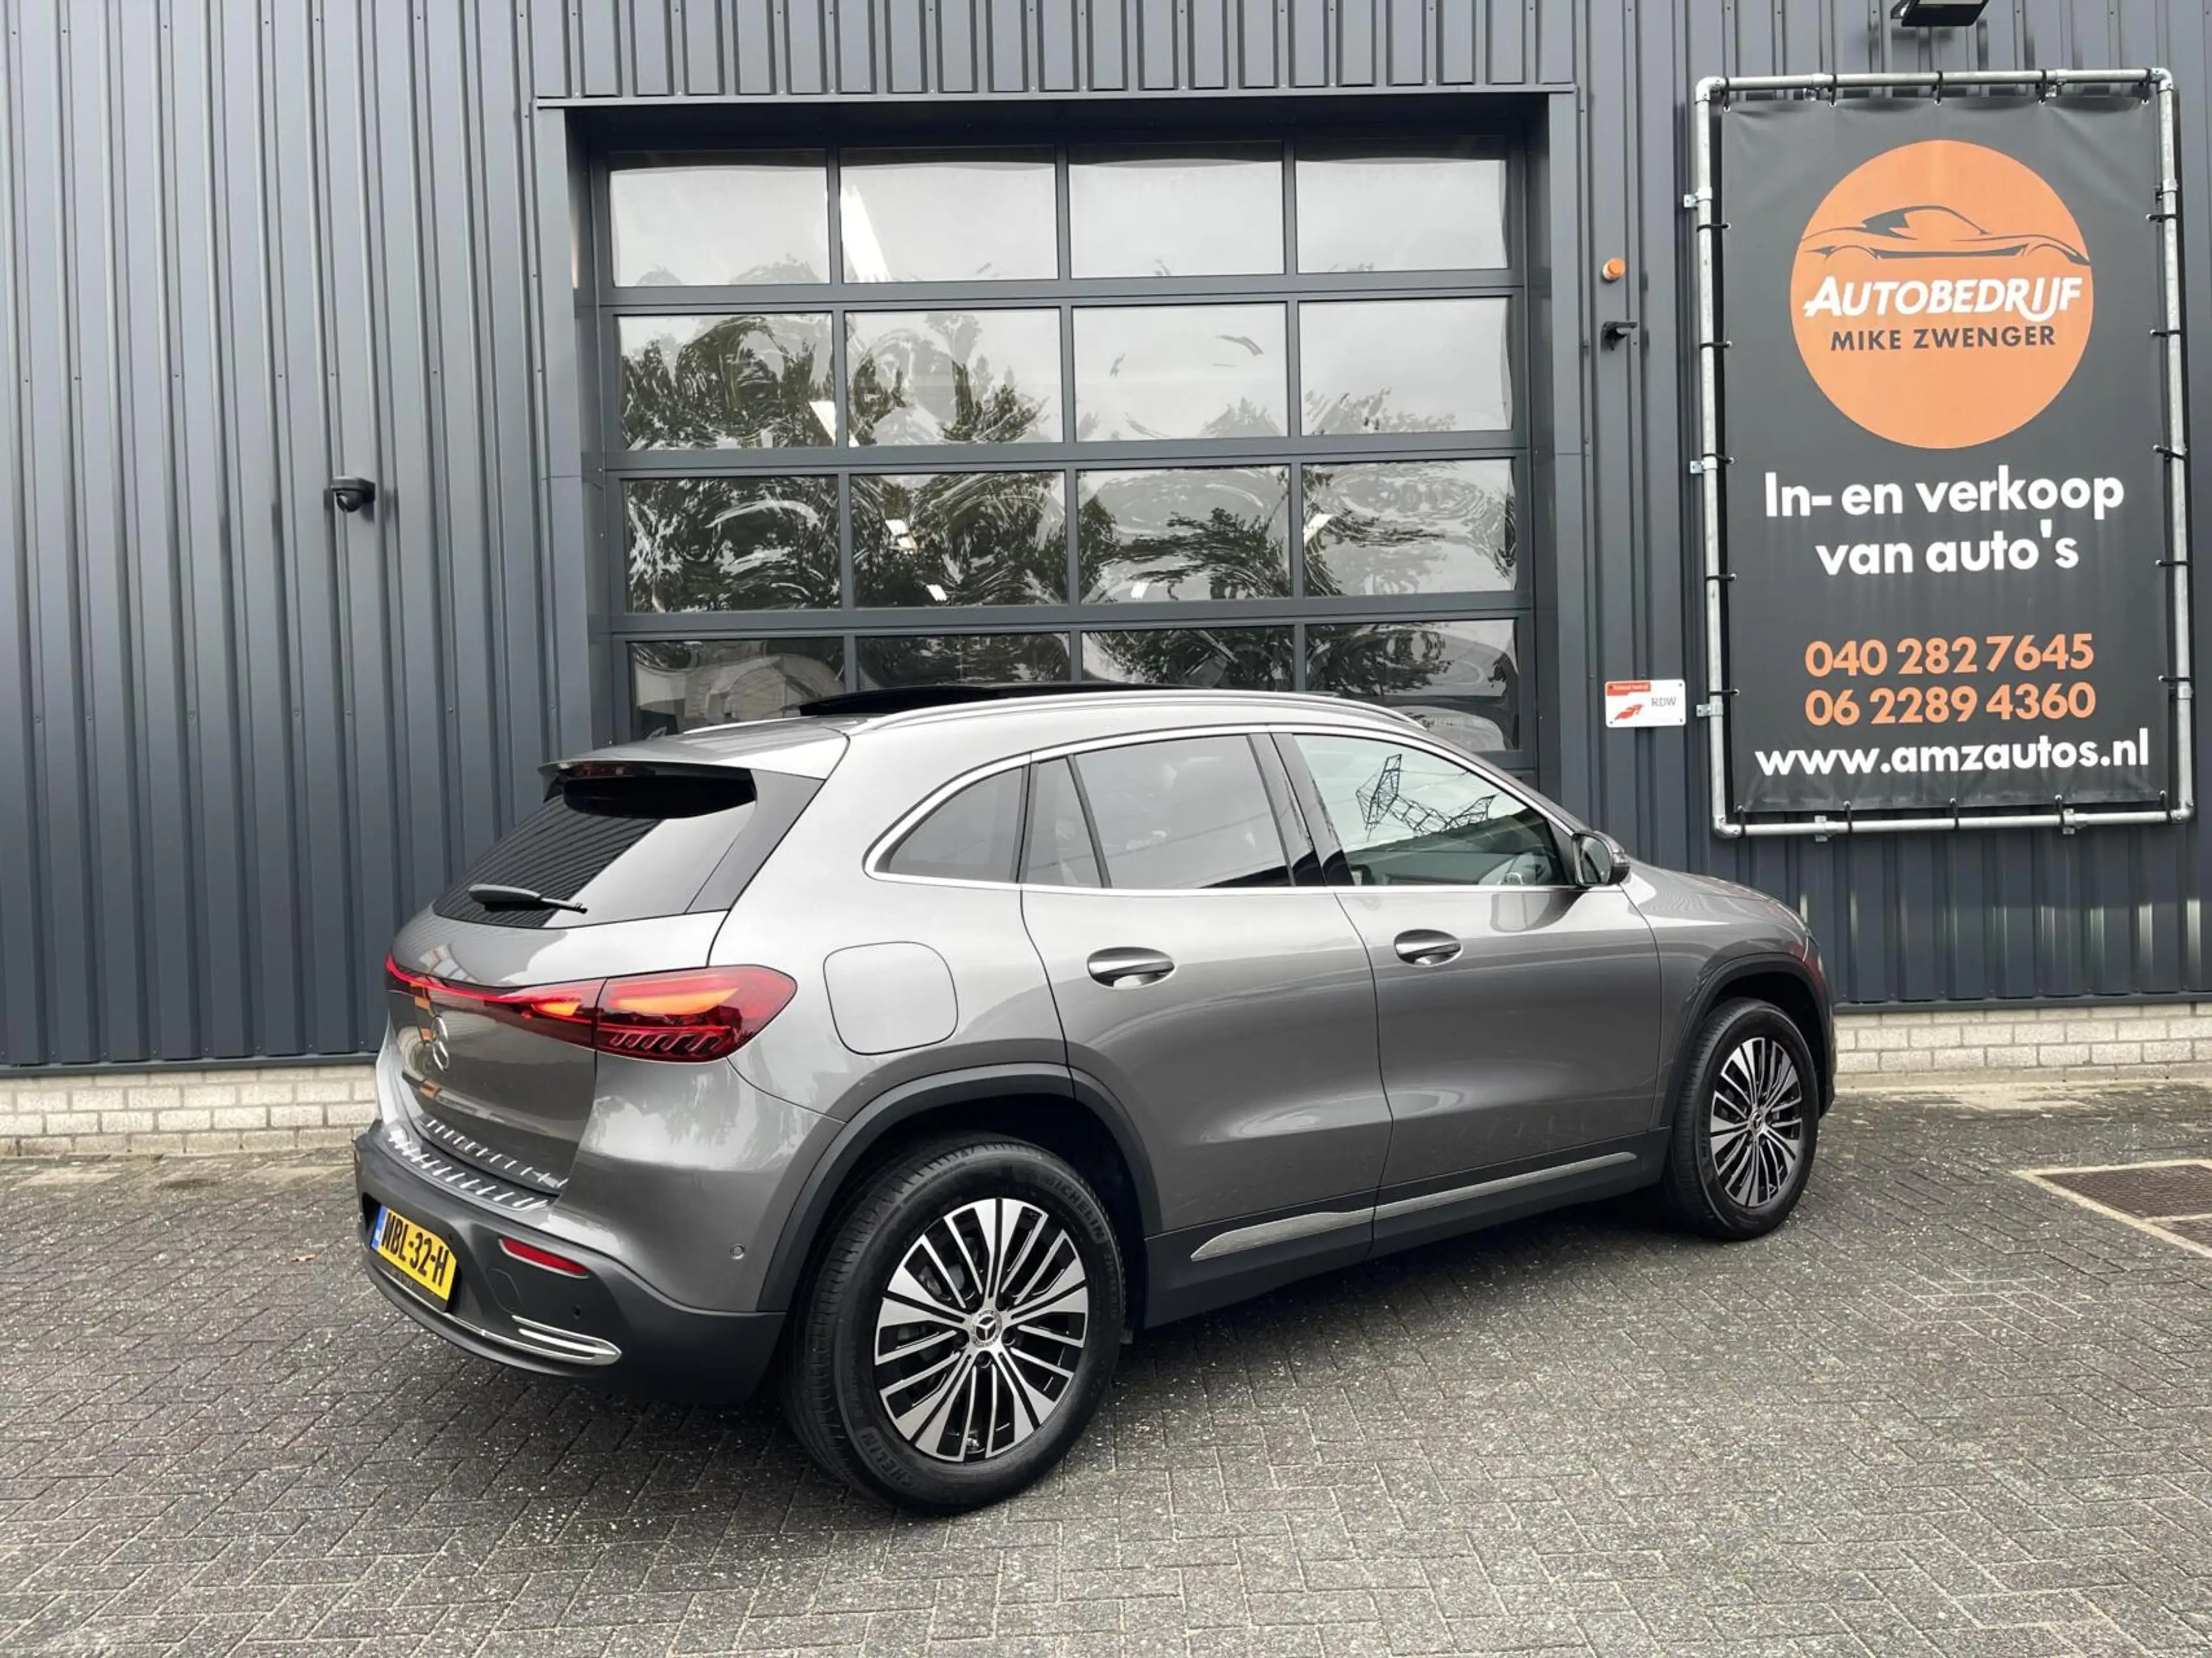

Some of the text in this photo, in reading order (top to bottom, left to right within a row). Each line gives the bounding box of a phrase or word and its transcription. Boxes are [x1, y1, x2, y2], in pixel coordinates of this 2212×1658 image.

[1804, 276, 2082, 323] AUTOBEDRIJF
[1831, 325, 2055, 351] MIKE ZWENGER
[1765, 465, 2124, 520] In- en verkoop
[1815, 519, 2079, 575] van auto's
[1805, 632, 2094, 678] 040 282 7645
[1651, 697, 1676, 707] RDW
[1805, 681, 2096, 726] 06 2289 4360
[1755, 727, 2149, 776] www.amzautos.nl
